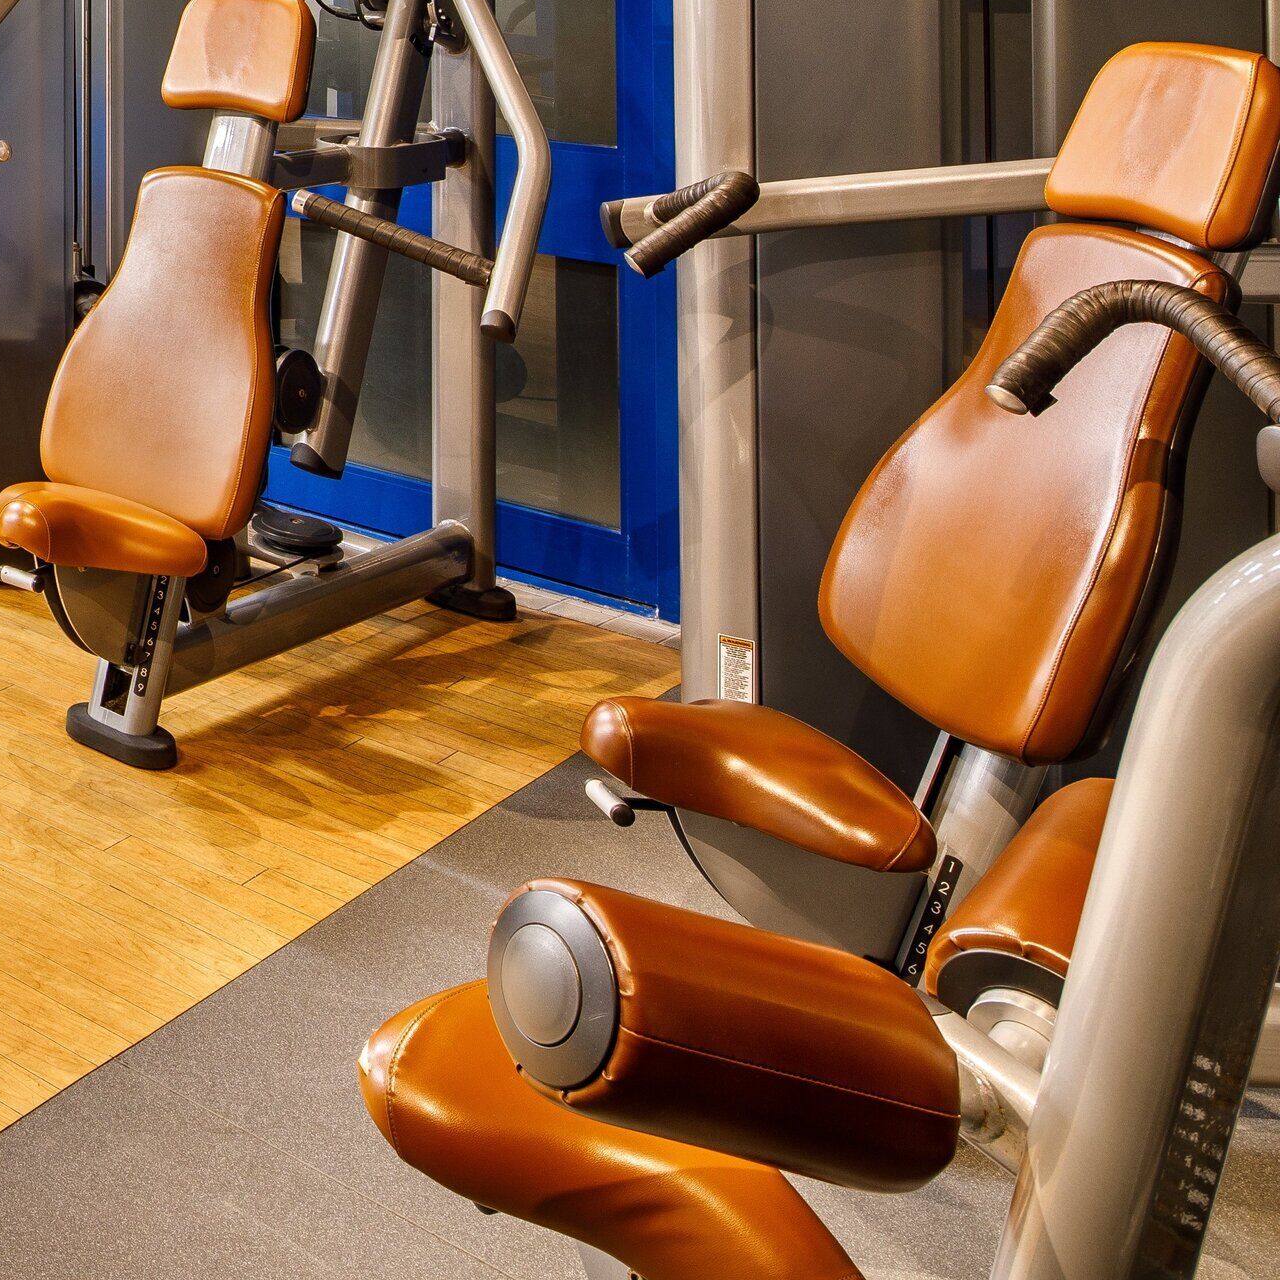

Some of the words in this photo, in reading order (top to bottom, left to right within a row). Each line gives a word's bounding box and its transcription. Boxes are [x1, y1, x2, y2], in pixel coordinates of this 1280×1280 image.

[160, 576, 167, 585] 2
[157, 591, 164, 600] 3
[154, 607, 160, 615] 4
[151, 622, 157, 631] 5
[147, 638, 153, 646] 6
[140, 668, 148, 677] 8
[138, 683, 144, 692] 9
[949, 861, 955, 872] 1
[938, 881, 950, 895] 2
[930, 901, 942, 914] 3
[923, 924, 934, 935] 4
[915, 942, 927, 954] 5
[907, 963, 917, 975] 6
